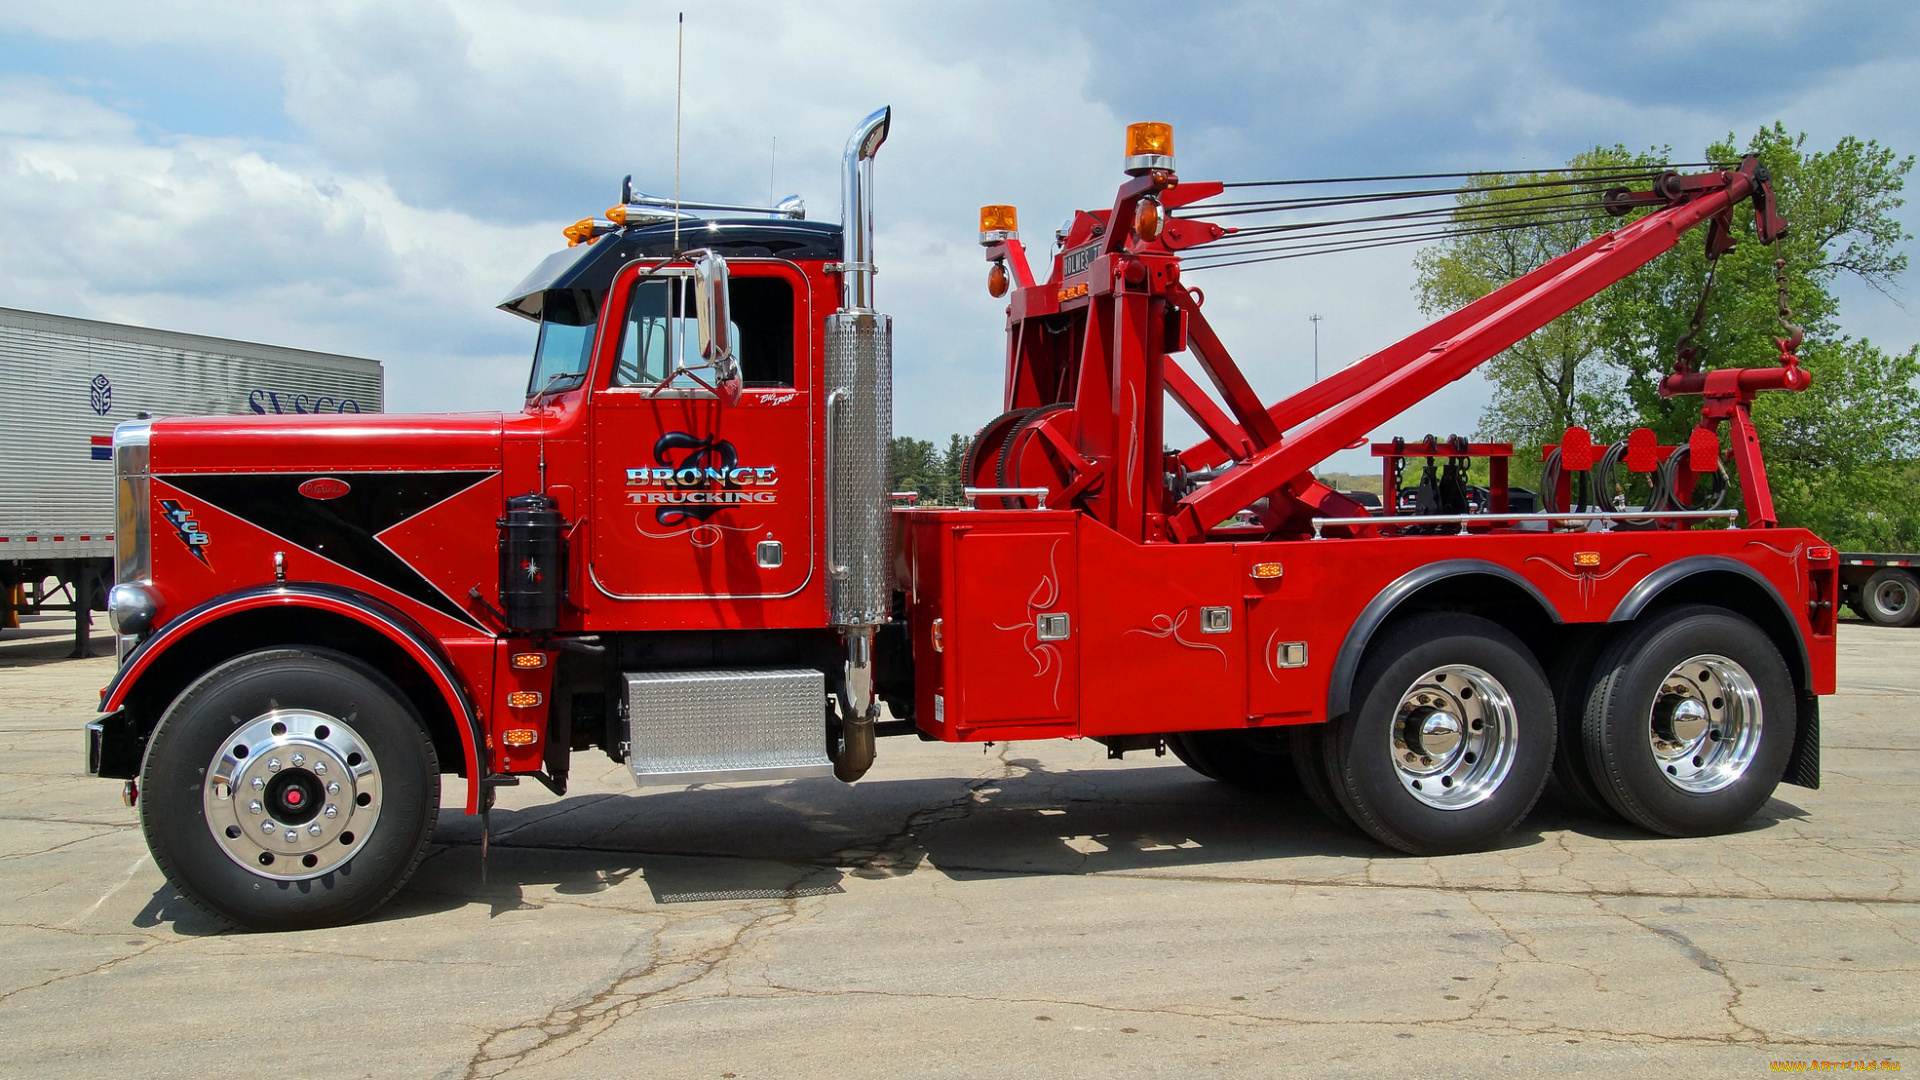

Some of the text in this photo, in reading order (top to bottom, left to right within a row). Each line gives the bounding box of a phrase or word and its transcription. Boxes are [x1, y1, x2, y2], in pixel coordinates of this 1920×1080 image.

[625, 466, 779, 487] BRONGE
[627, 491, 777, 503] TRUCKING
[172, 509, 209, 545] TCB
